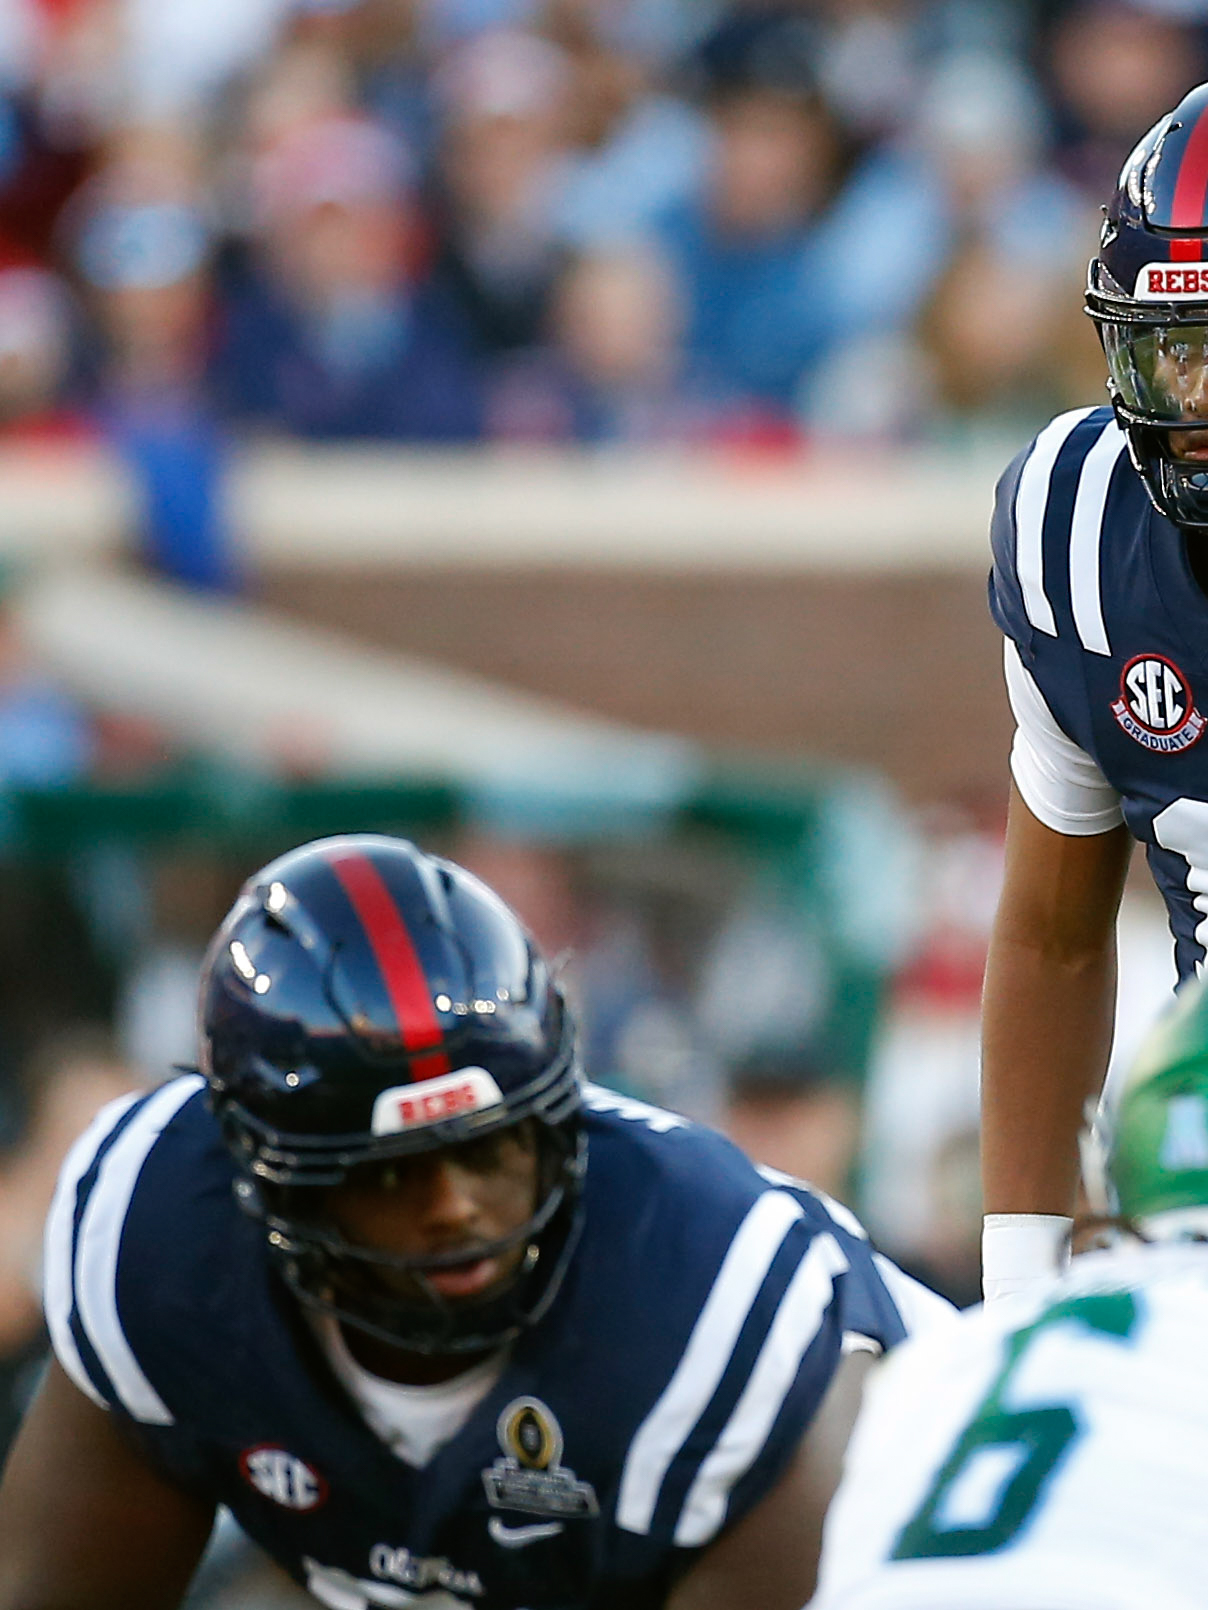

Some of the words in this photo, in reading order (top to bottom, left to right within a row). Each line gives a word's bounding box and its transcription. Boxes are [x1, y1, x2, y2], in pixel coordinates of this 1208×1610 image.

[1126, 660, 1184, 730] SEC
[1123, 717, 1194, 752] GRADUATE
[888, 1293, 1144, 1562] 6
[246, 1449, 319, 1511] SEC
